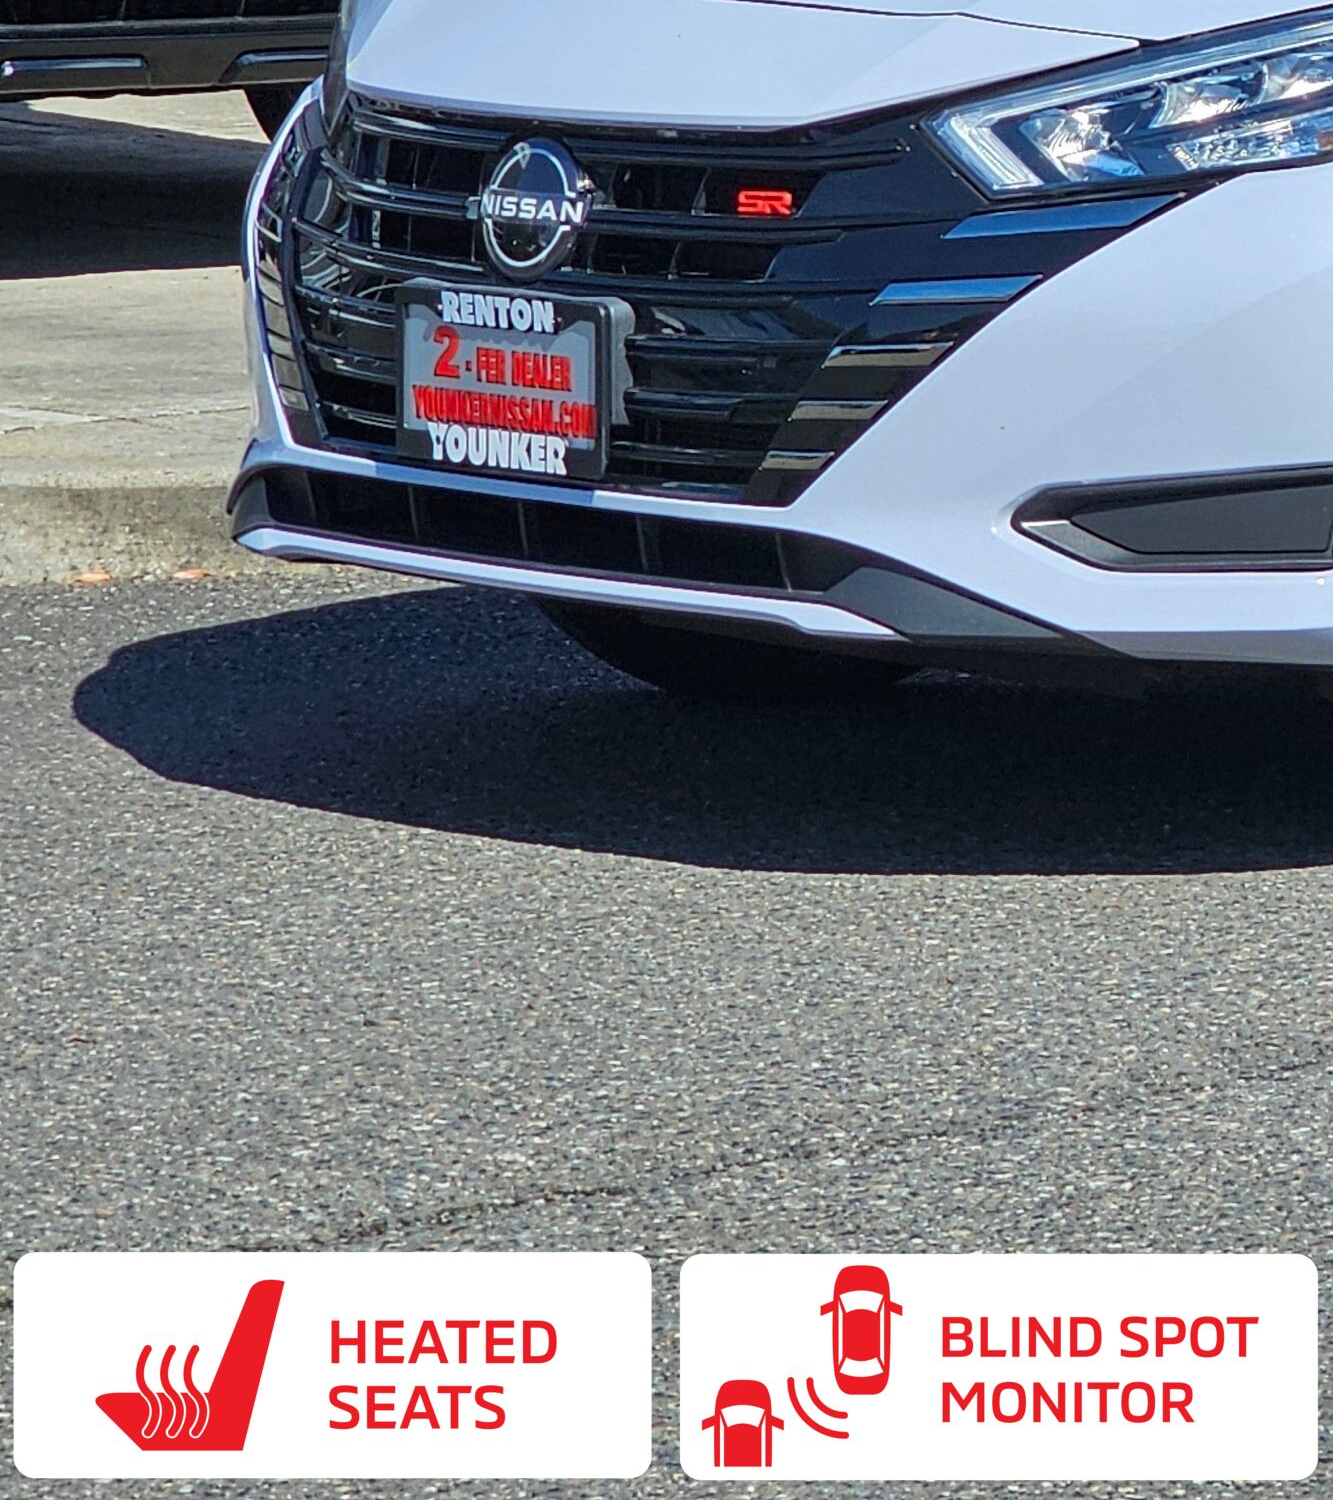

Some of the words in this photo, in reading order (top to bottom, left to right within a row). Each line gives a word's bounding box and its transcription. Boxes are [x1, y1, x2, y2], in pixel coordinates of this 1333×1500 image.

[480, 192, 584, 223] NISSAN
[737, 190, 793, 216] SR
[440, 290, 555, 333] RENTON
[433, 325, 461, 379] 2
[476, 346, 506, 386] FER
[511, 350, 573, 393] DEALER
[412, 384, 597, 439] YOUNKERNISSAN.COM
[426, 421, 568, 476] YOUNKER
